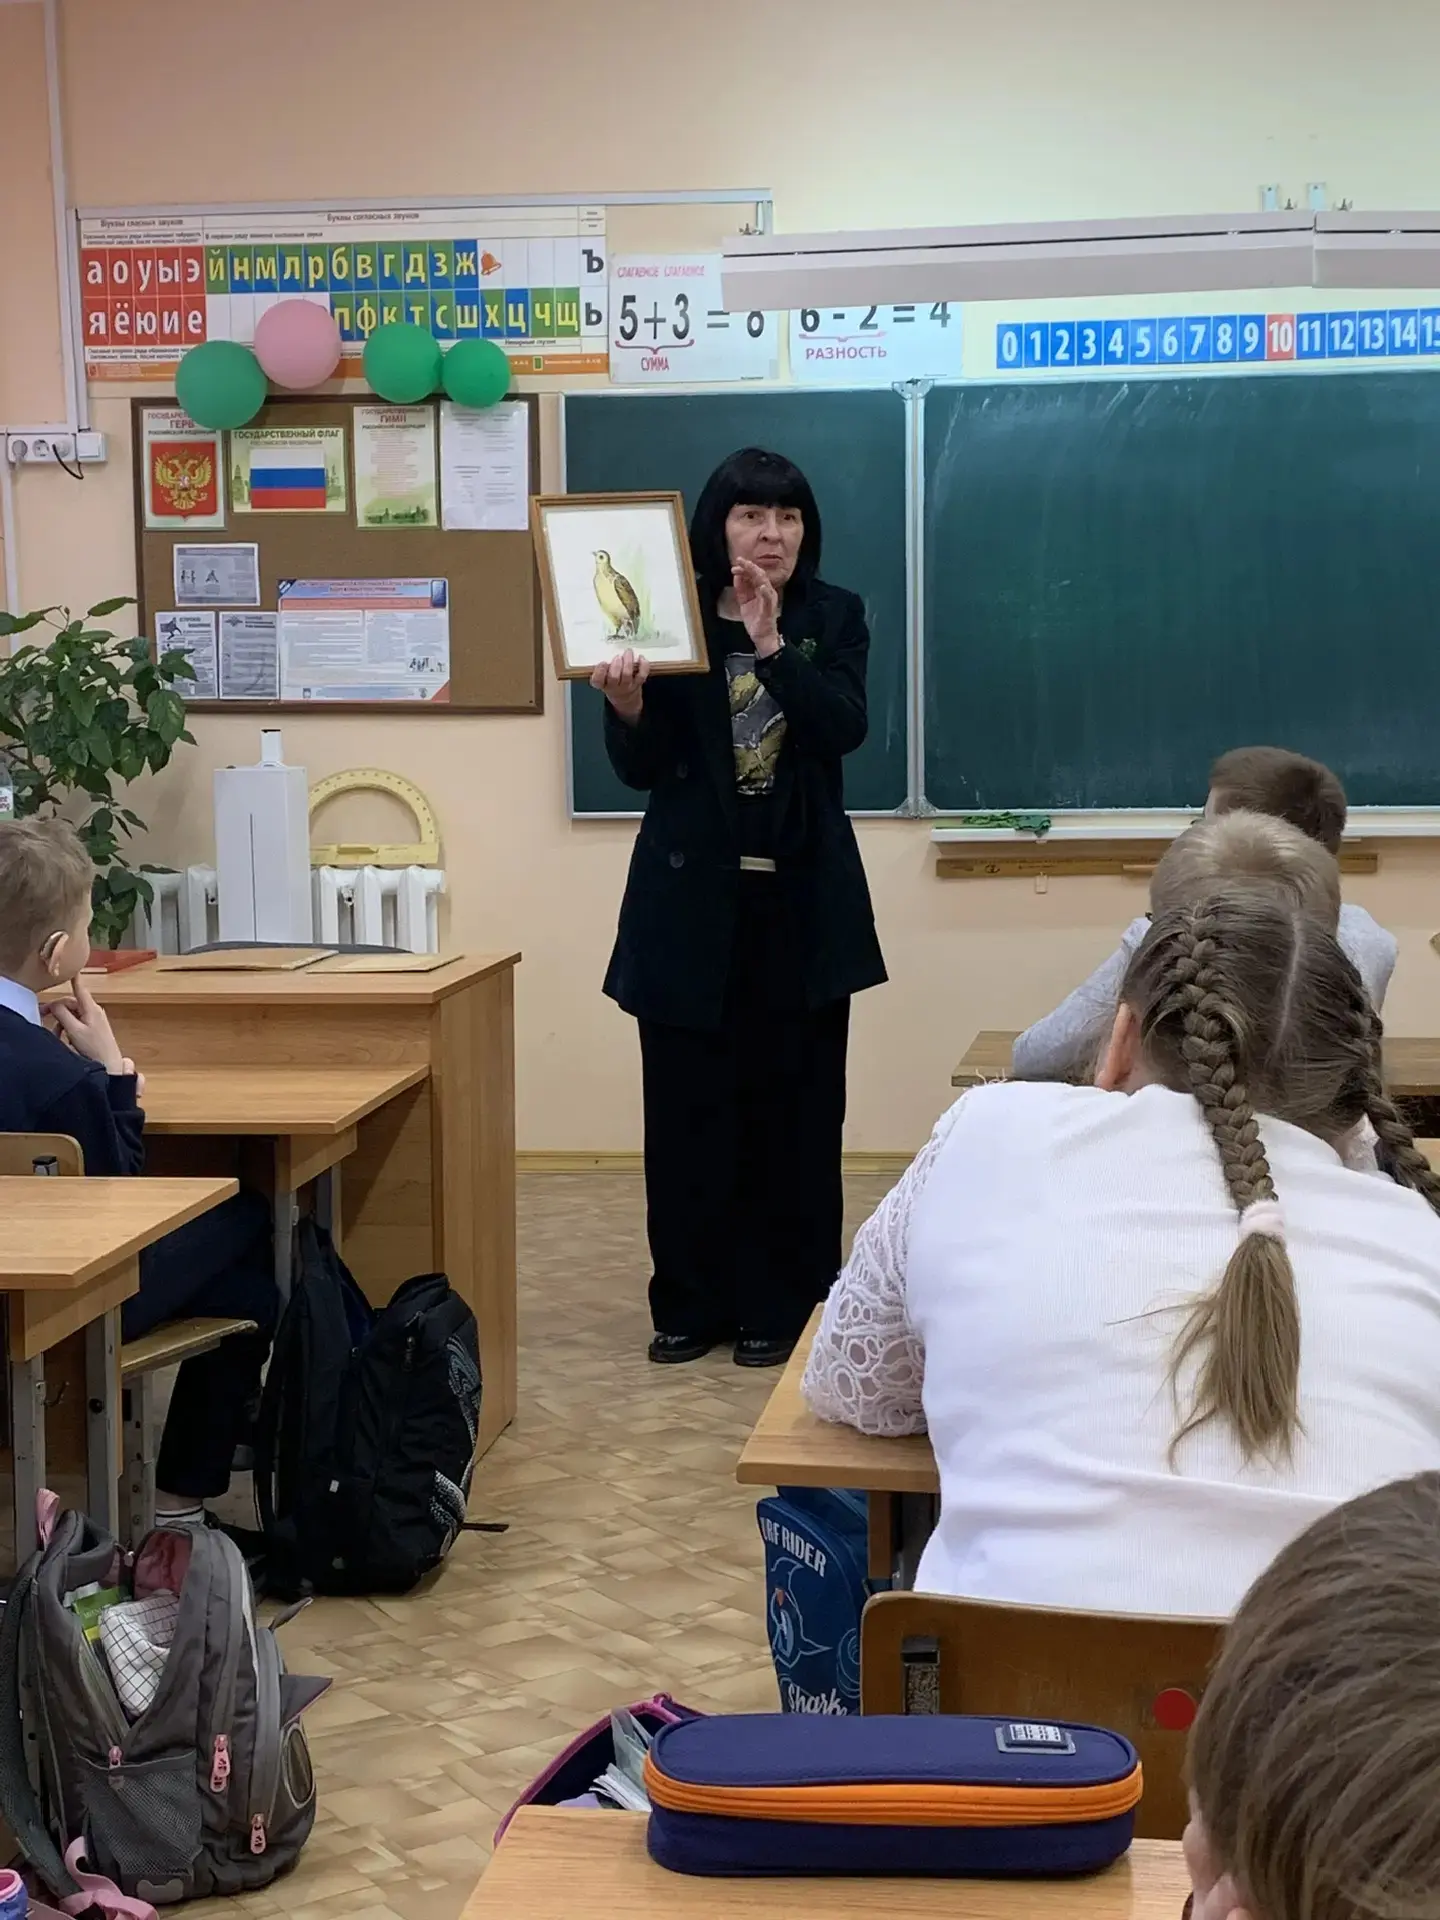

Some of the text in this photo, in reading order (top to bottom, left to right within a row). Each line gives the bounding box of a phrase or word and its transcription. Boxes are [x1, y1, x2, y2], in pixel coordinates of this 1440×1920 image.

[87, 258, 201, 293] а о у ы э
[208, 246, 476, 288] й н м л р б в г д з ж
[89, 302, 203, 335] я ё ю и е
[333, 298, 579, 339] п ф к т с ш х ц ч щ
[805, 346, 887, 360] РАЗНОСТЬ
[1002, 330, 1018, 362] 0
[1029, 330, 1041, 361] 1
[1055, 329, 1070, 361] 2
[1082, 328, 1096, 360] 3
[1108, 327, 1125, 358] 4
[1135, 325, 1151, 358] 5
[1162, 324, 1178, 357] 6
[1189, 324, 1206, 356] 7
[1217, 322, 1233, 355] 8
[1243, 322, 1259, 354] 9
[1268, 321, 1292, 353] 10
[1298, 320, 1321, 352] 11
[1329, 318, 1355, 351] 12
[1359, 317, 1385, 350] 13
[1390, 315, 1417, 348] 14
[640, 356, 670, 372] СУММА
[234, 429, 340, 439] ГОСУДАРСТВЕННЫЙ ФЛАГ
[380, 414, 407, 423] ГИМН
[781, 1525, 827, 1578] RIDER
